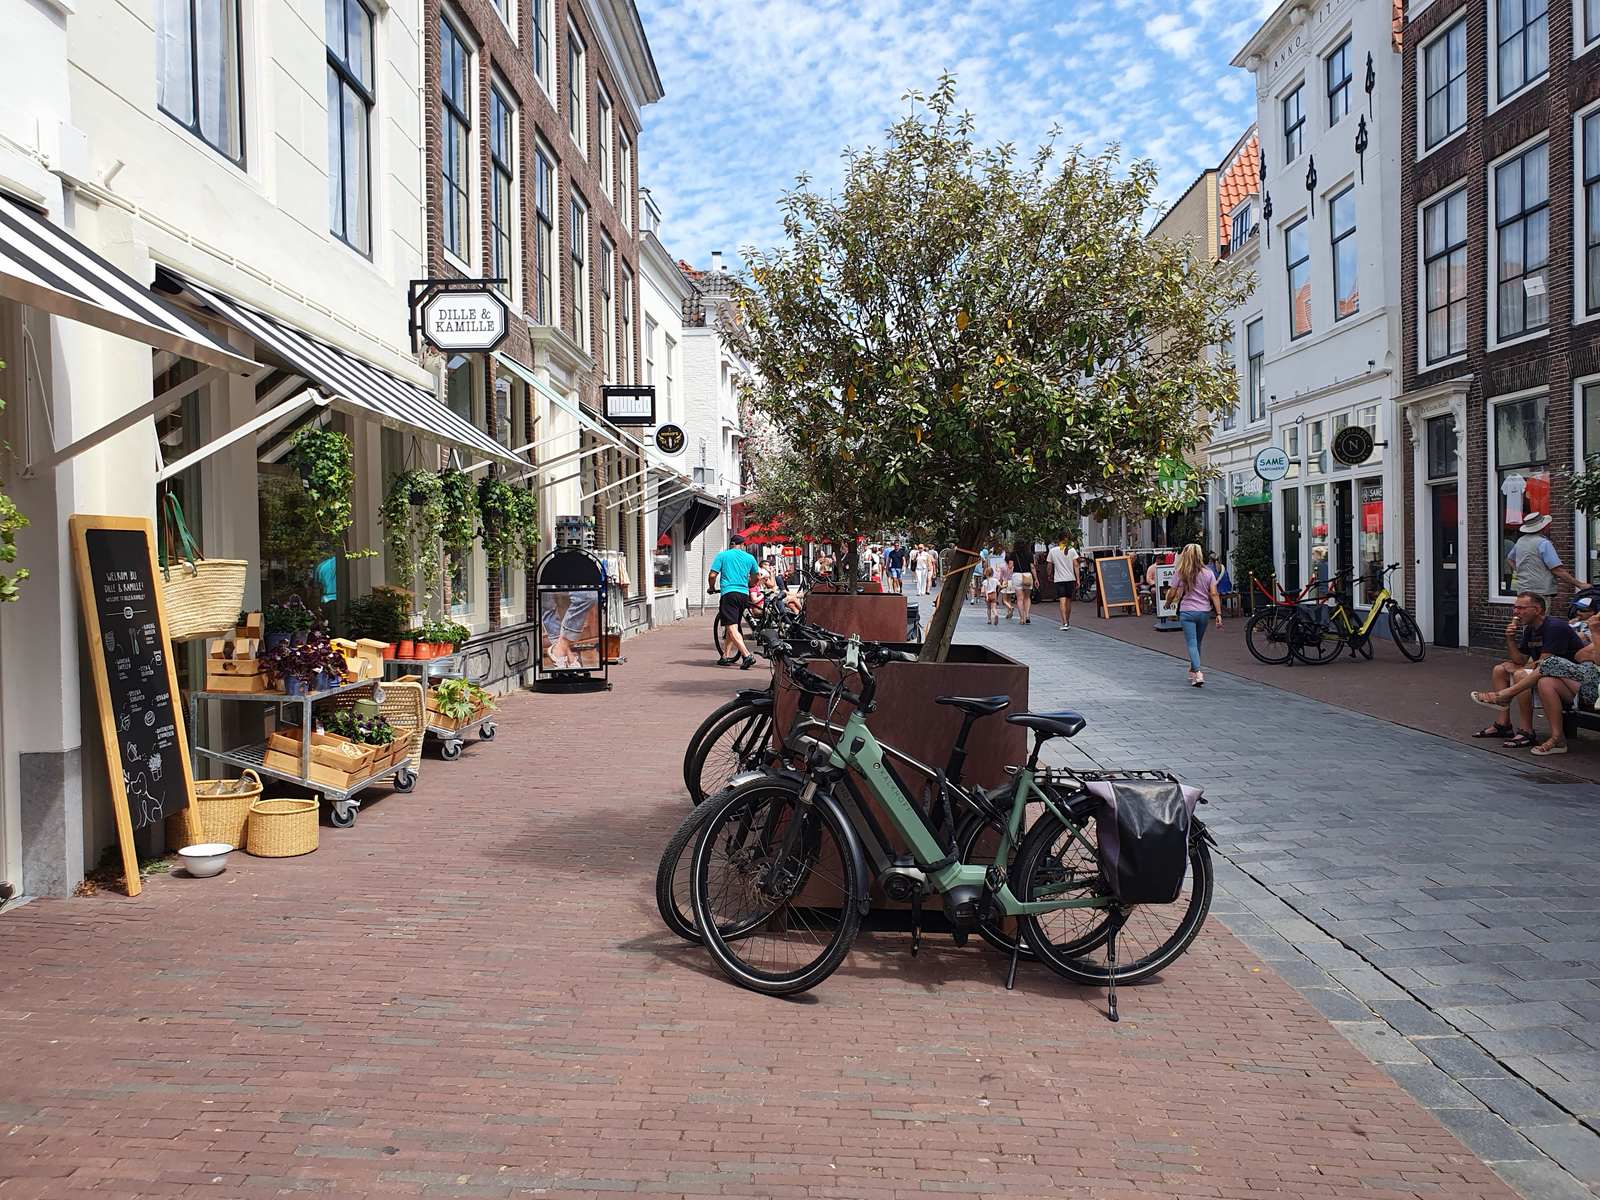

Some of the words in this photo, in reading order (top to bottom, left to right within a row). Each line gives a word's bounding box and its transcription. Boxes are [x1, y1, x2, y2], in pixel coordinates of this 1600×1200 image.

[438, 309, 477, 320] DILLE
[481, 308, 491, 320] &
[435, 320, 495, 332] KAMILLE
[1348, 439, 1360, 451] N
[1259, 457, 1285, 467] SAME
